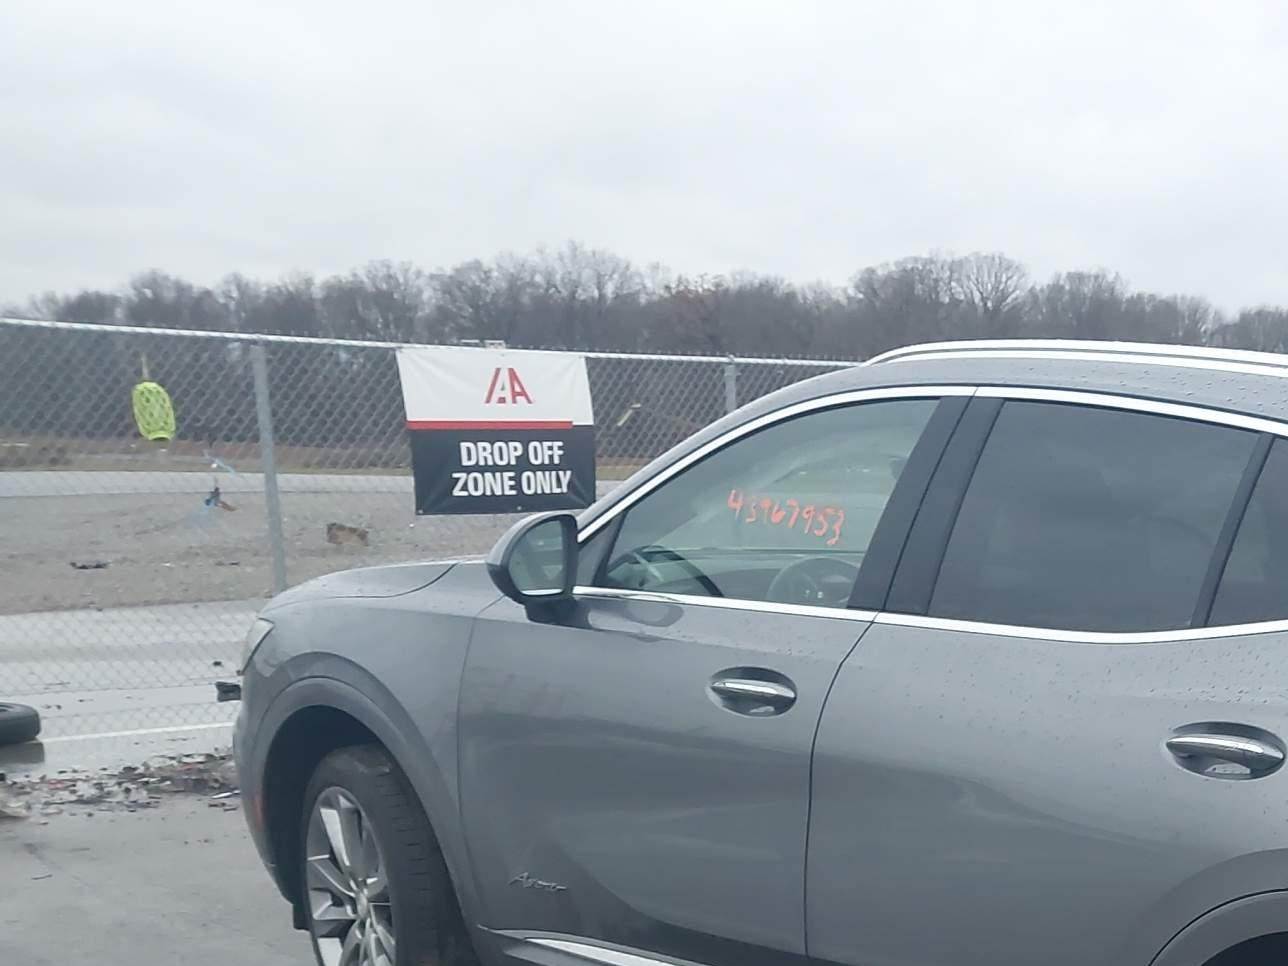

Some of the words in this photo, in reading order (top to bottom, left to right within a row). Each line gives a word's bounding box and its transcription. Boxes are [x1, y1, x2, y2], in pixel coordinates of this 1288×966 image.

[459, 441, 523, 467] DROP
[528, 441, 564, 465] OFF
[452, 471, 517, 497] ZONE
[521, 470, 572, 495] ONLY
[727, 489, 845, 545] 43967953
